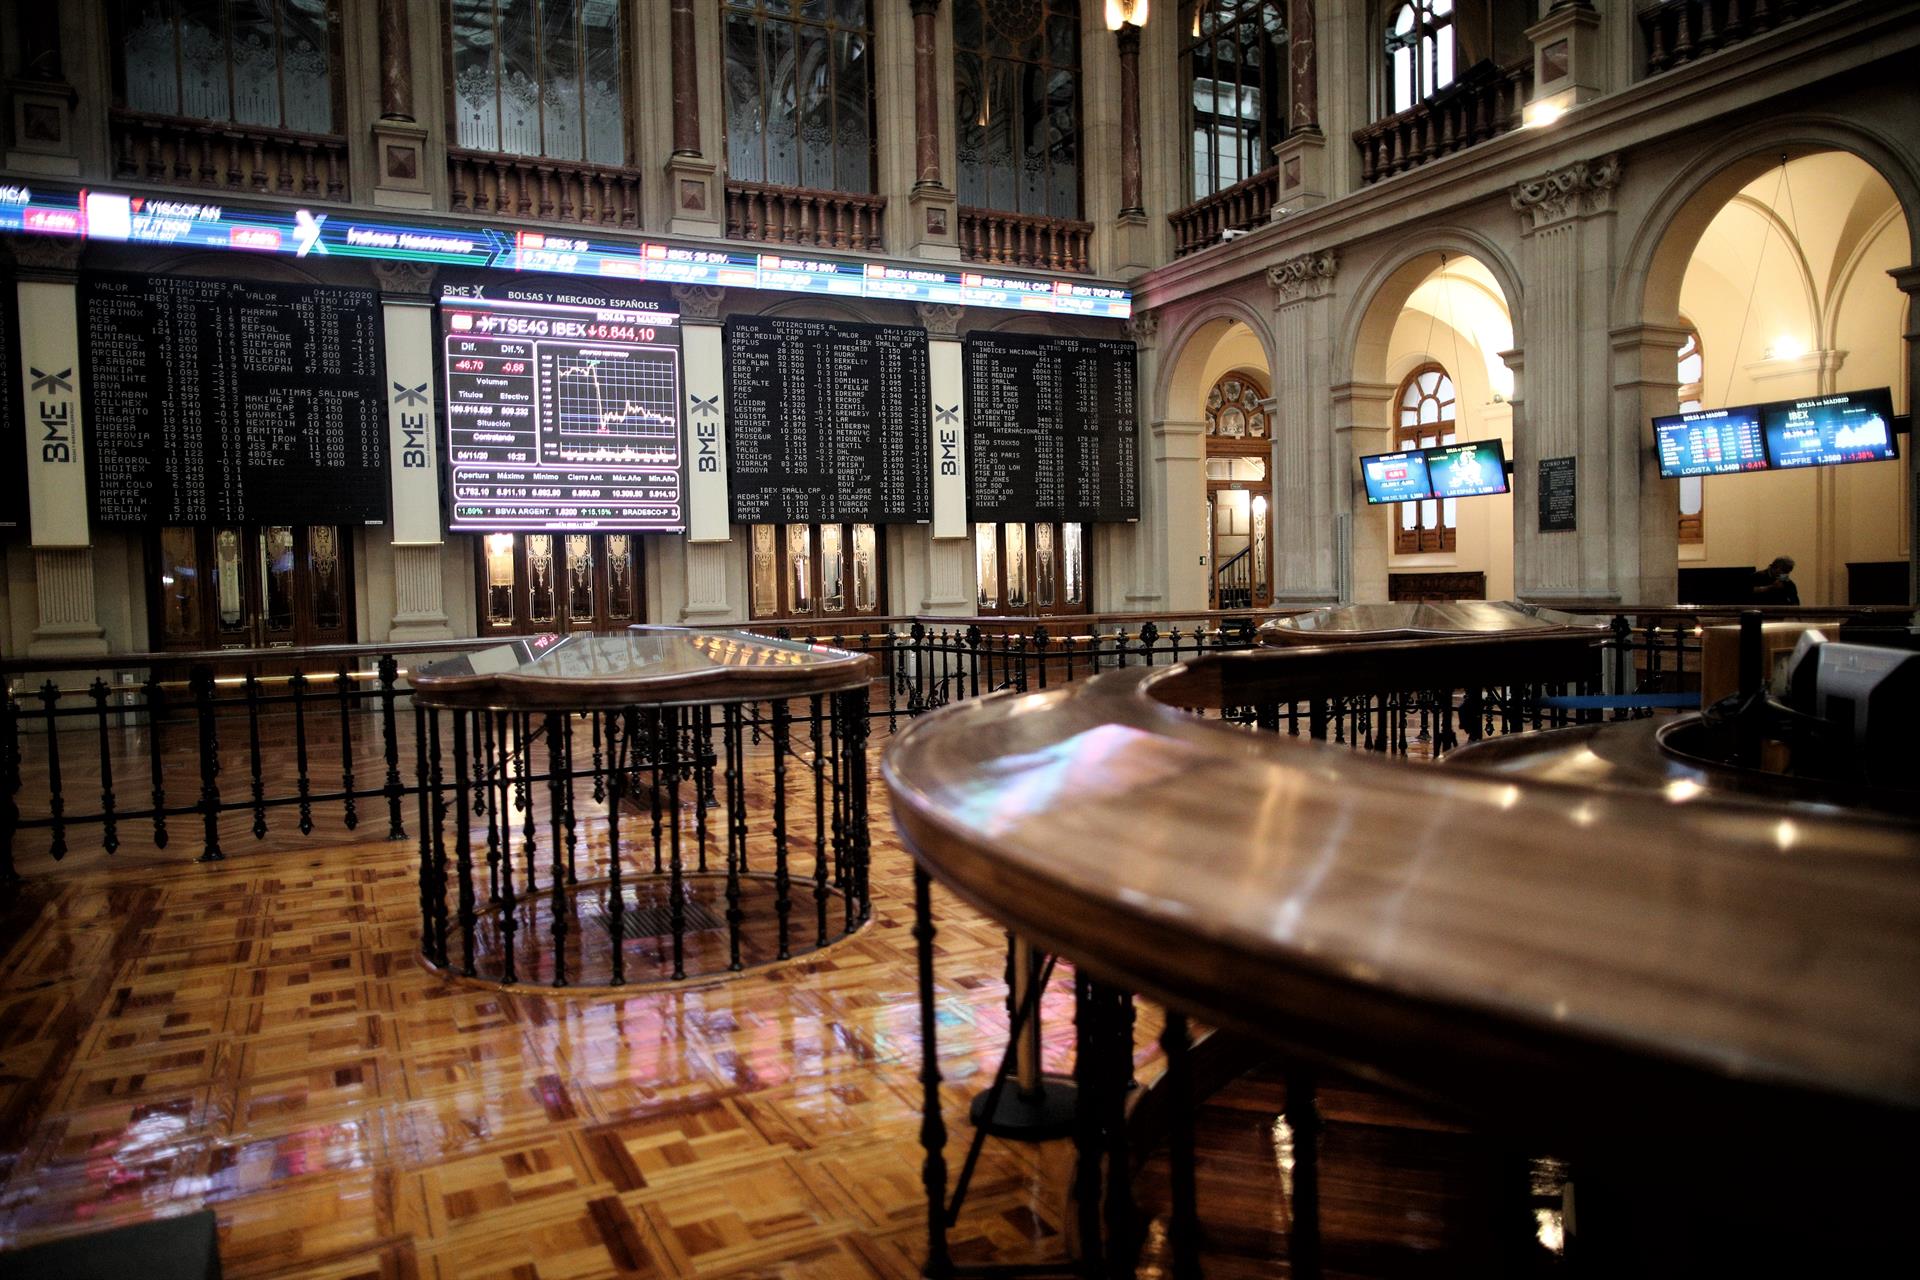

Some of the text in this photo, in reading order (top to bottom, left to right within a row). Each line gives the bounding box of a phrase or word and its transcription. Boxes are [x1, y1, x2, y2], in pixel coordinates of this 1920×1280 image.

[146, 200, 221, 221] VISCOFAN
[545, 238, 572, 249] IBEX
[668, 249, 693, 260] IBEX
[781, 260, 804, 270] IBEX
[886, 269, 945, 282] IBEX MEDIUM
[95, 282, 128, 292] VALOR
[148, 278, 246, 292] COTIZACIONES AL
[982, 278, 1051, 291] IBEX SMALL CAP
[313, 289, 372, 300] 04/11/2020
[443, 285, 469, 296] BME
[1073, 286, 1124, 298] IBEX TOP DIV
[89, 299, 137, 308] ACCIONA
[508, 291, 543, 301] BOLSAS
[556, 295, 606, 306] MERCADOS
[610, 299, 659, 310] ESPAÑOLES
[89, 307, 144, 317] ACERINOX
[240, 308, 278, 317] PHARMA
[241, 324, 278, 333] REPSOL
[489, 317, 655, 341] FTSE4G IBEX 6.844,10
[772, 321, 824, 330] COTIZACIONES
[91, 332, 146, 341] ALMIRALL
[241, 332, 292, 341] SANTANDE
[883, 328, 924, 337] 04/11/2020
[91, 340, 139, 349] AMADEUS
[461, 342, 524, 354] Dif. Dif.%
[92, 348, 146, 358] ARCELORM
[242, 348, 286, 357] SOLARIA
[242, 356, 293, 365] TELEFONI
[92, 365, 133, 373] BANKIA
[243, 364, 293, 373] VISCOFAN
[93, 381, 120, 389] BBVA
[94, 390, 148, 398] CAIXABAN
[269, 387, 360, 398] ULTIMAS SALIDAS
[94, 398, 142, 406] CELLNEX
[95, 414, 136, 422] ENAGAS
[1789, 410, 1809, 420] IBEX
[477, 419, 510, 428] Situación
[40, 402, 69, 462] BME
[96, 431, 151, 439] FERROVIA
[401, 412, 425, 468] BME
[473, 433, 515, 442] Contratando
[96, 439, 144, 447] GRIFOLS
[697, 423, 716, 472] BME
[940, 430, 956, 475] BME
[1780, 457, 1812, 466] MAPFRE
[1681, 466, 1710, 475] LOGISTA
[458, 472, 490, 482] Apertura
